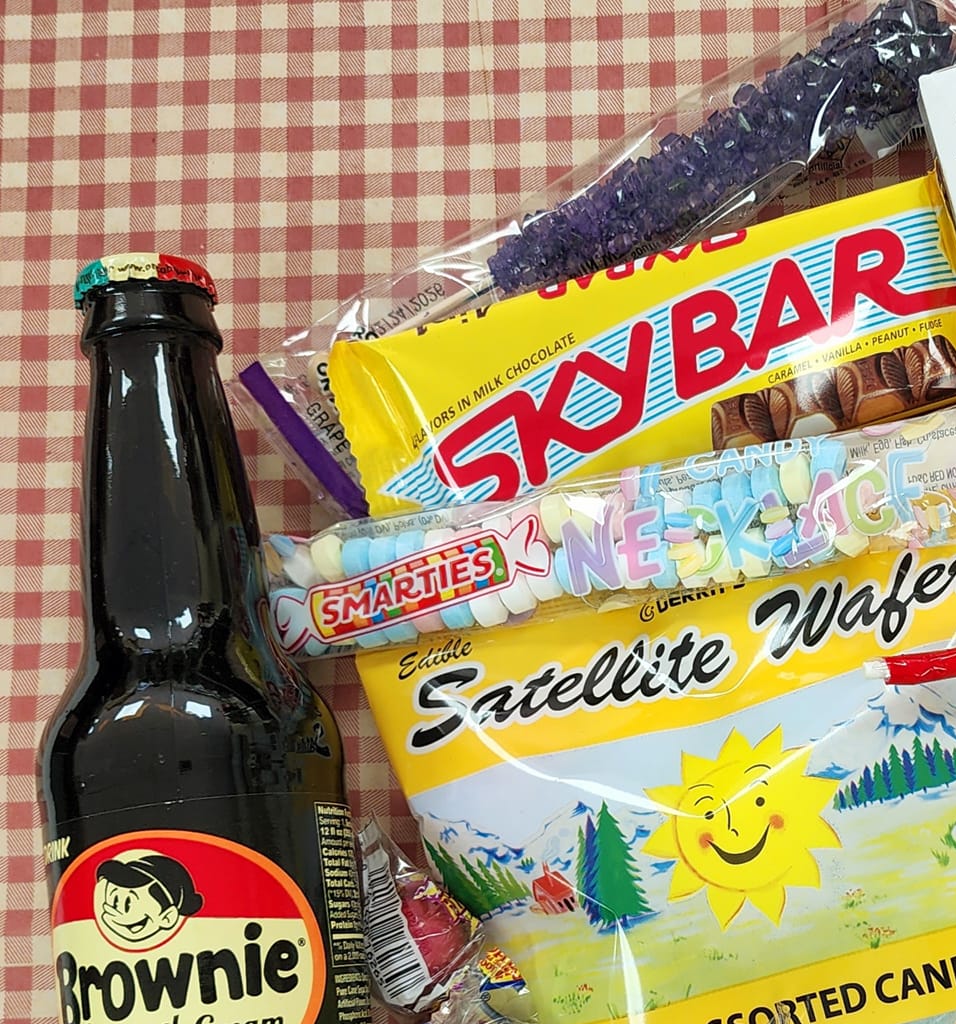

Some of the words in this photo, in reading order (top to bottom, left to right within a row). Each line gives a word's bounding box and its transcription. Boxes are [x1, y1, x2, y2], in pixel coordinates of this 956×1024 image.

[505, 331, 576, 383] CHOCOLATE
[767, 361, 813, 384] CARAMEL
[822, 342, 862, 365] VANILLA
[871, 326, 909, 347] PEANUT
[919, 317, 943, 335] FUDGE
[306, 403, 350, 453] GRAPE
[684, 436, 826, 479] CANDY
[321, 549, 494, 627] SMARTIES
[398, 638, 473, 680] Edible
[411, 631, 730, 748] Satellite
